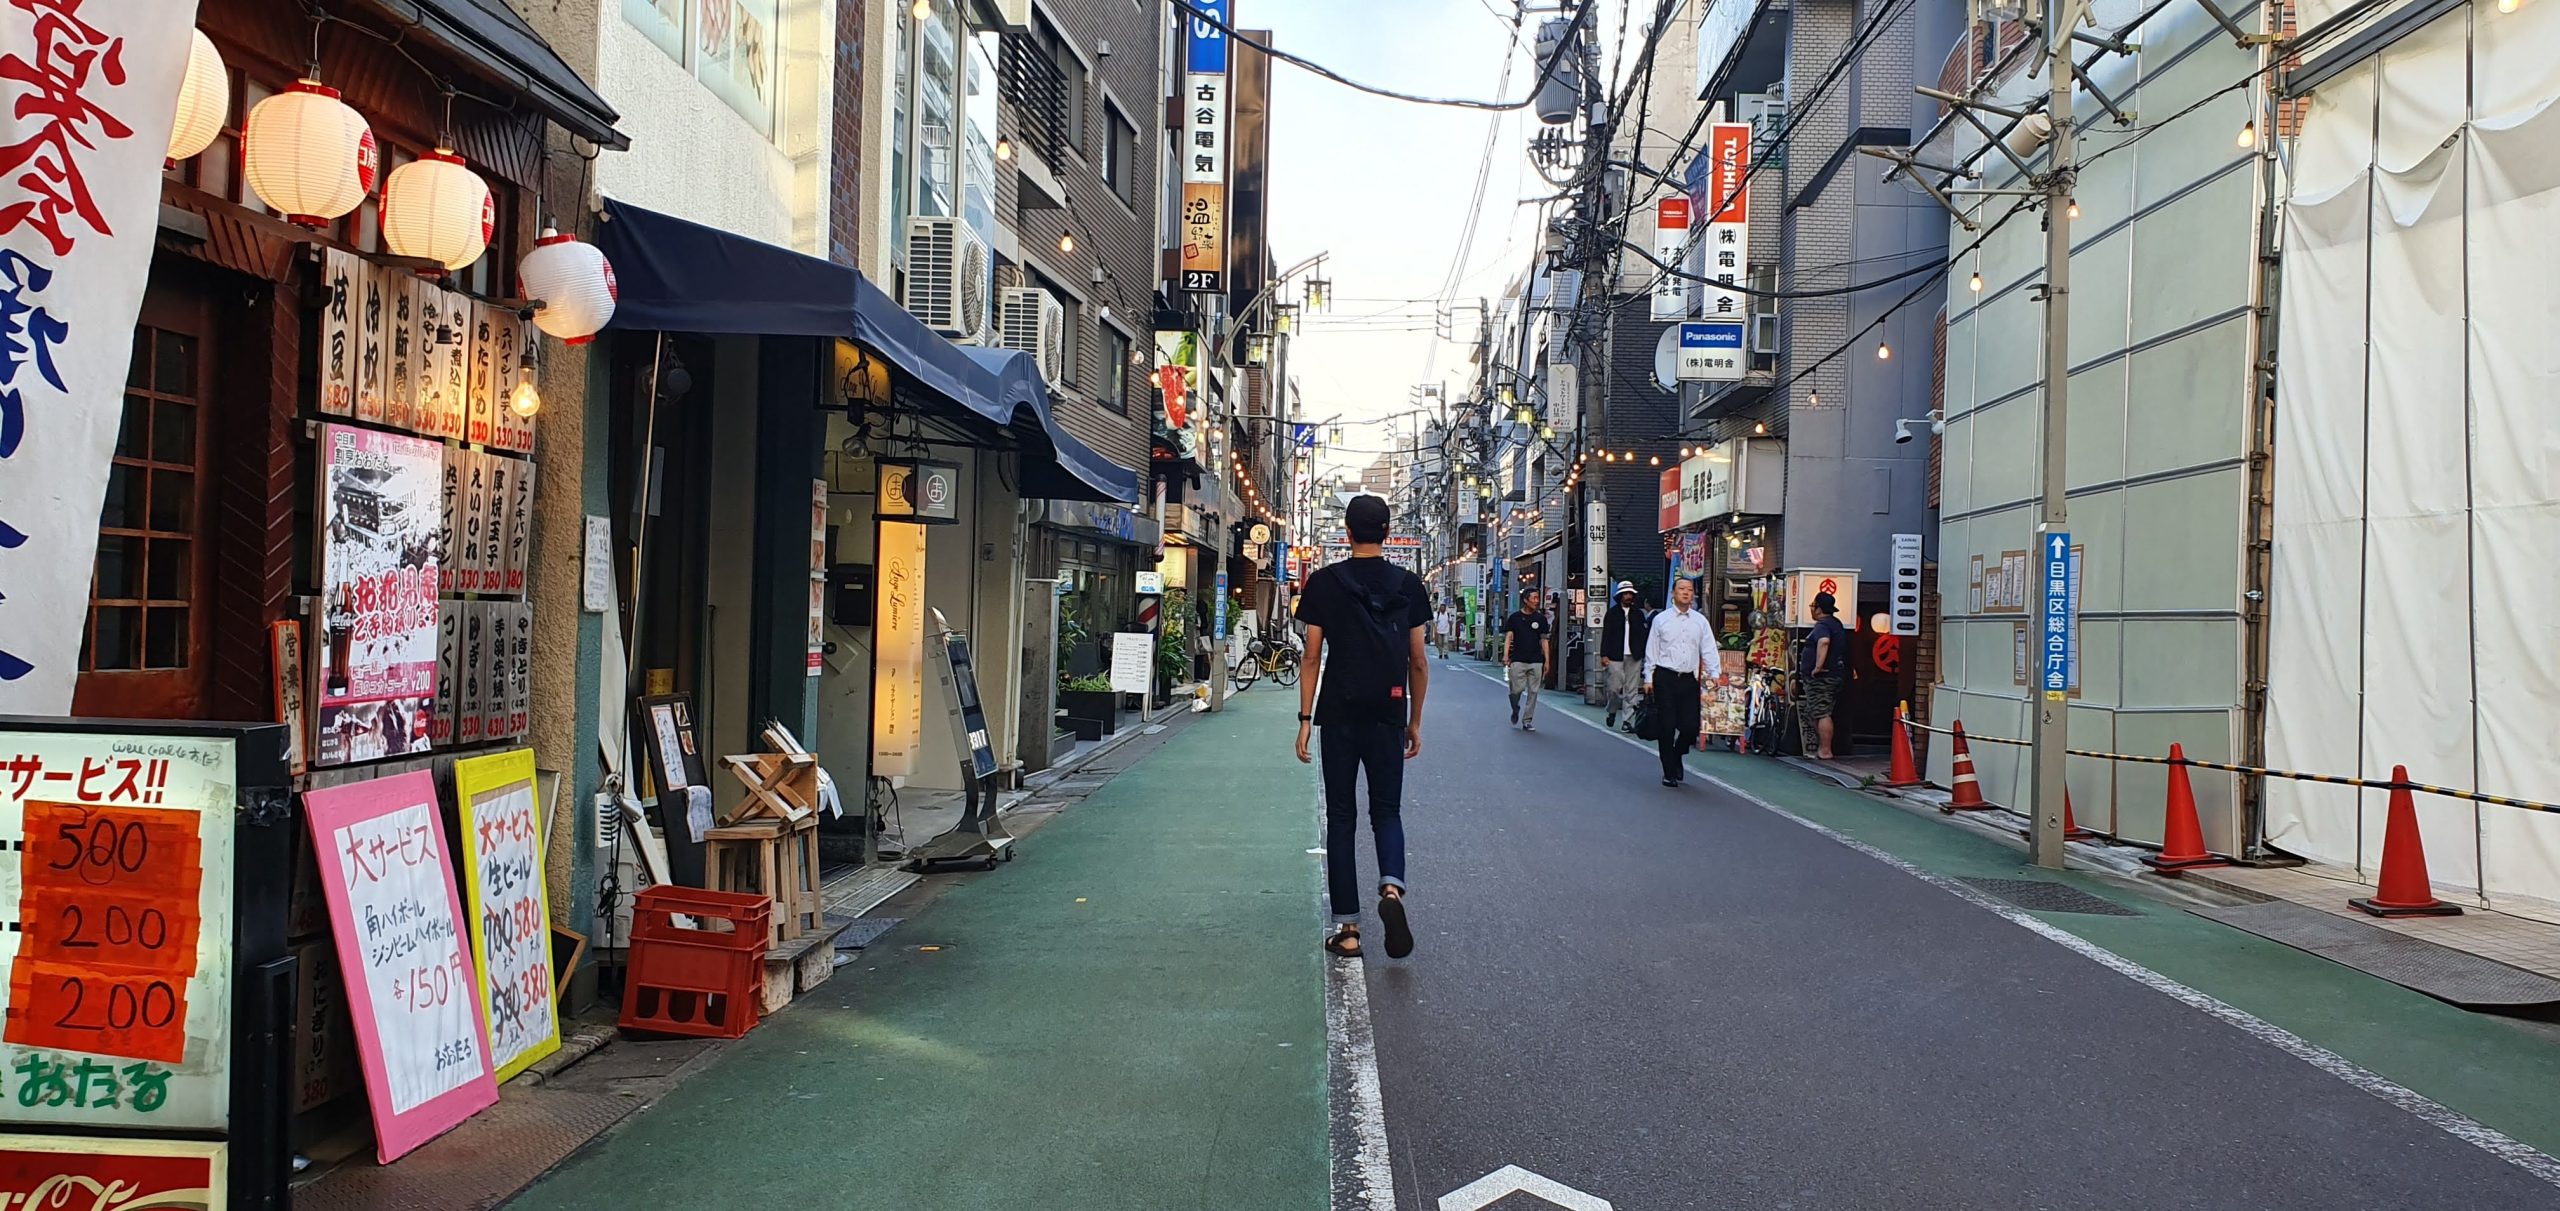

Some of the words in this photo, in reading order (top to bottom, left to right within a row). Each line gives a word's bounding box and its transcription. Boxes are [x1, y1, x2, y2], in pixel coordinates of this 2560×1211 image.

[1195, 84, 1216, 172] 古谷電気
[1188, 272, 1214, 288] 2F
[1660, 246, 1670, 297] オー電化
[1672, 246, 1683, 297] 太発電
[330, 266, 349, 381] 枝豆
[364, 280, 382, 391] 冷奴
[1685, 332, 1737, 342] Panasonic
[472, 320, 490, 415] あたりめ
[500, 327, 512, 425] スパイシーポテト
[1686, 358, 1734, 368] (株)電明舎
[415, 409, 436, 431] 330
[441, 411, 461, 434] 330
[471, 420, 488, 441] 330
[496, 426, 513, 446] 330
[516, 430, 532, 450] 330
[465, 467, 482, 561] えいひれ
[487, 470, 505, 567] 厚焼玉子
[513, 480, 528, 562] エノキバター
[460, 569, 480, 590] 330
[483, 570, 501, 590] 380
[506, 569, 524, 590] 380
[2047, 562, 2065, 688] 目黒区総合庁舎
[285, 633, 300, 720] 営業中
[439, 614, 455, 699] つくね
[517, 617, 528, 694] やきとり
[462, 715, 480, 736] 330
[487, 716, 505, 737] 430
[510, 711, 527, 733] 530
[0, 753, 169, 804] サービス!!
[346, 825, 437, 891] 大サービス
[488, 854, 532, 897] 生ビール
[60, 904, 166, 949] 200
[365, 896, 426, 942] 角ハイボール
[514, 895, 541, 943] 580
[55, 976, 176, 1031] 200
[521, 962, 548, 1013] 380
[434, 1037, 472, 1072] おおたる
[15, 1053, 173, 1112] おたる
